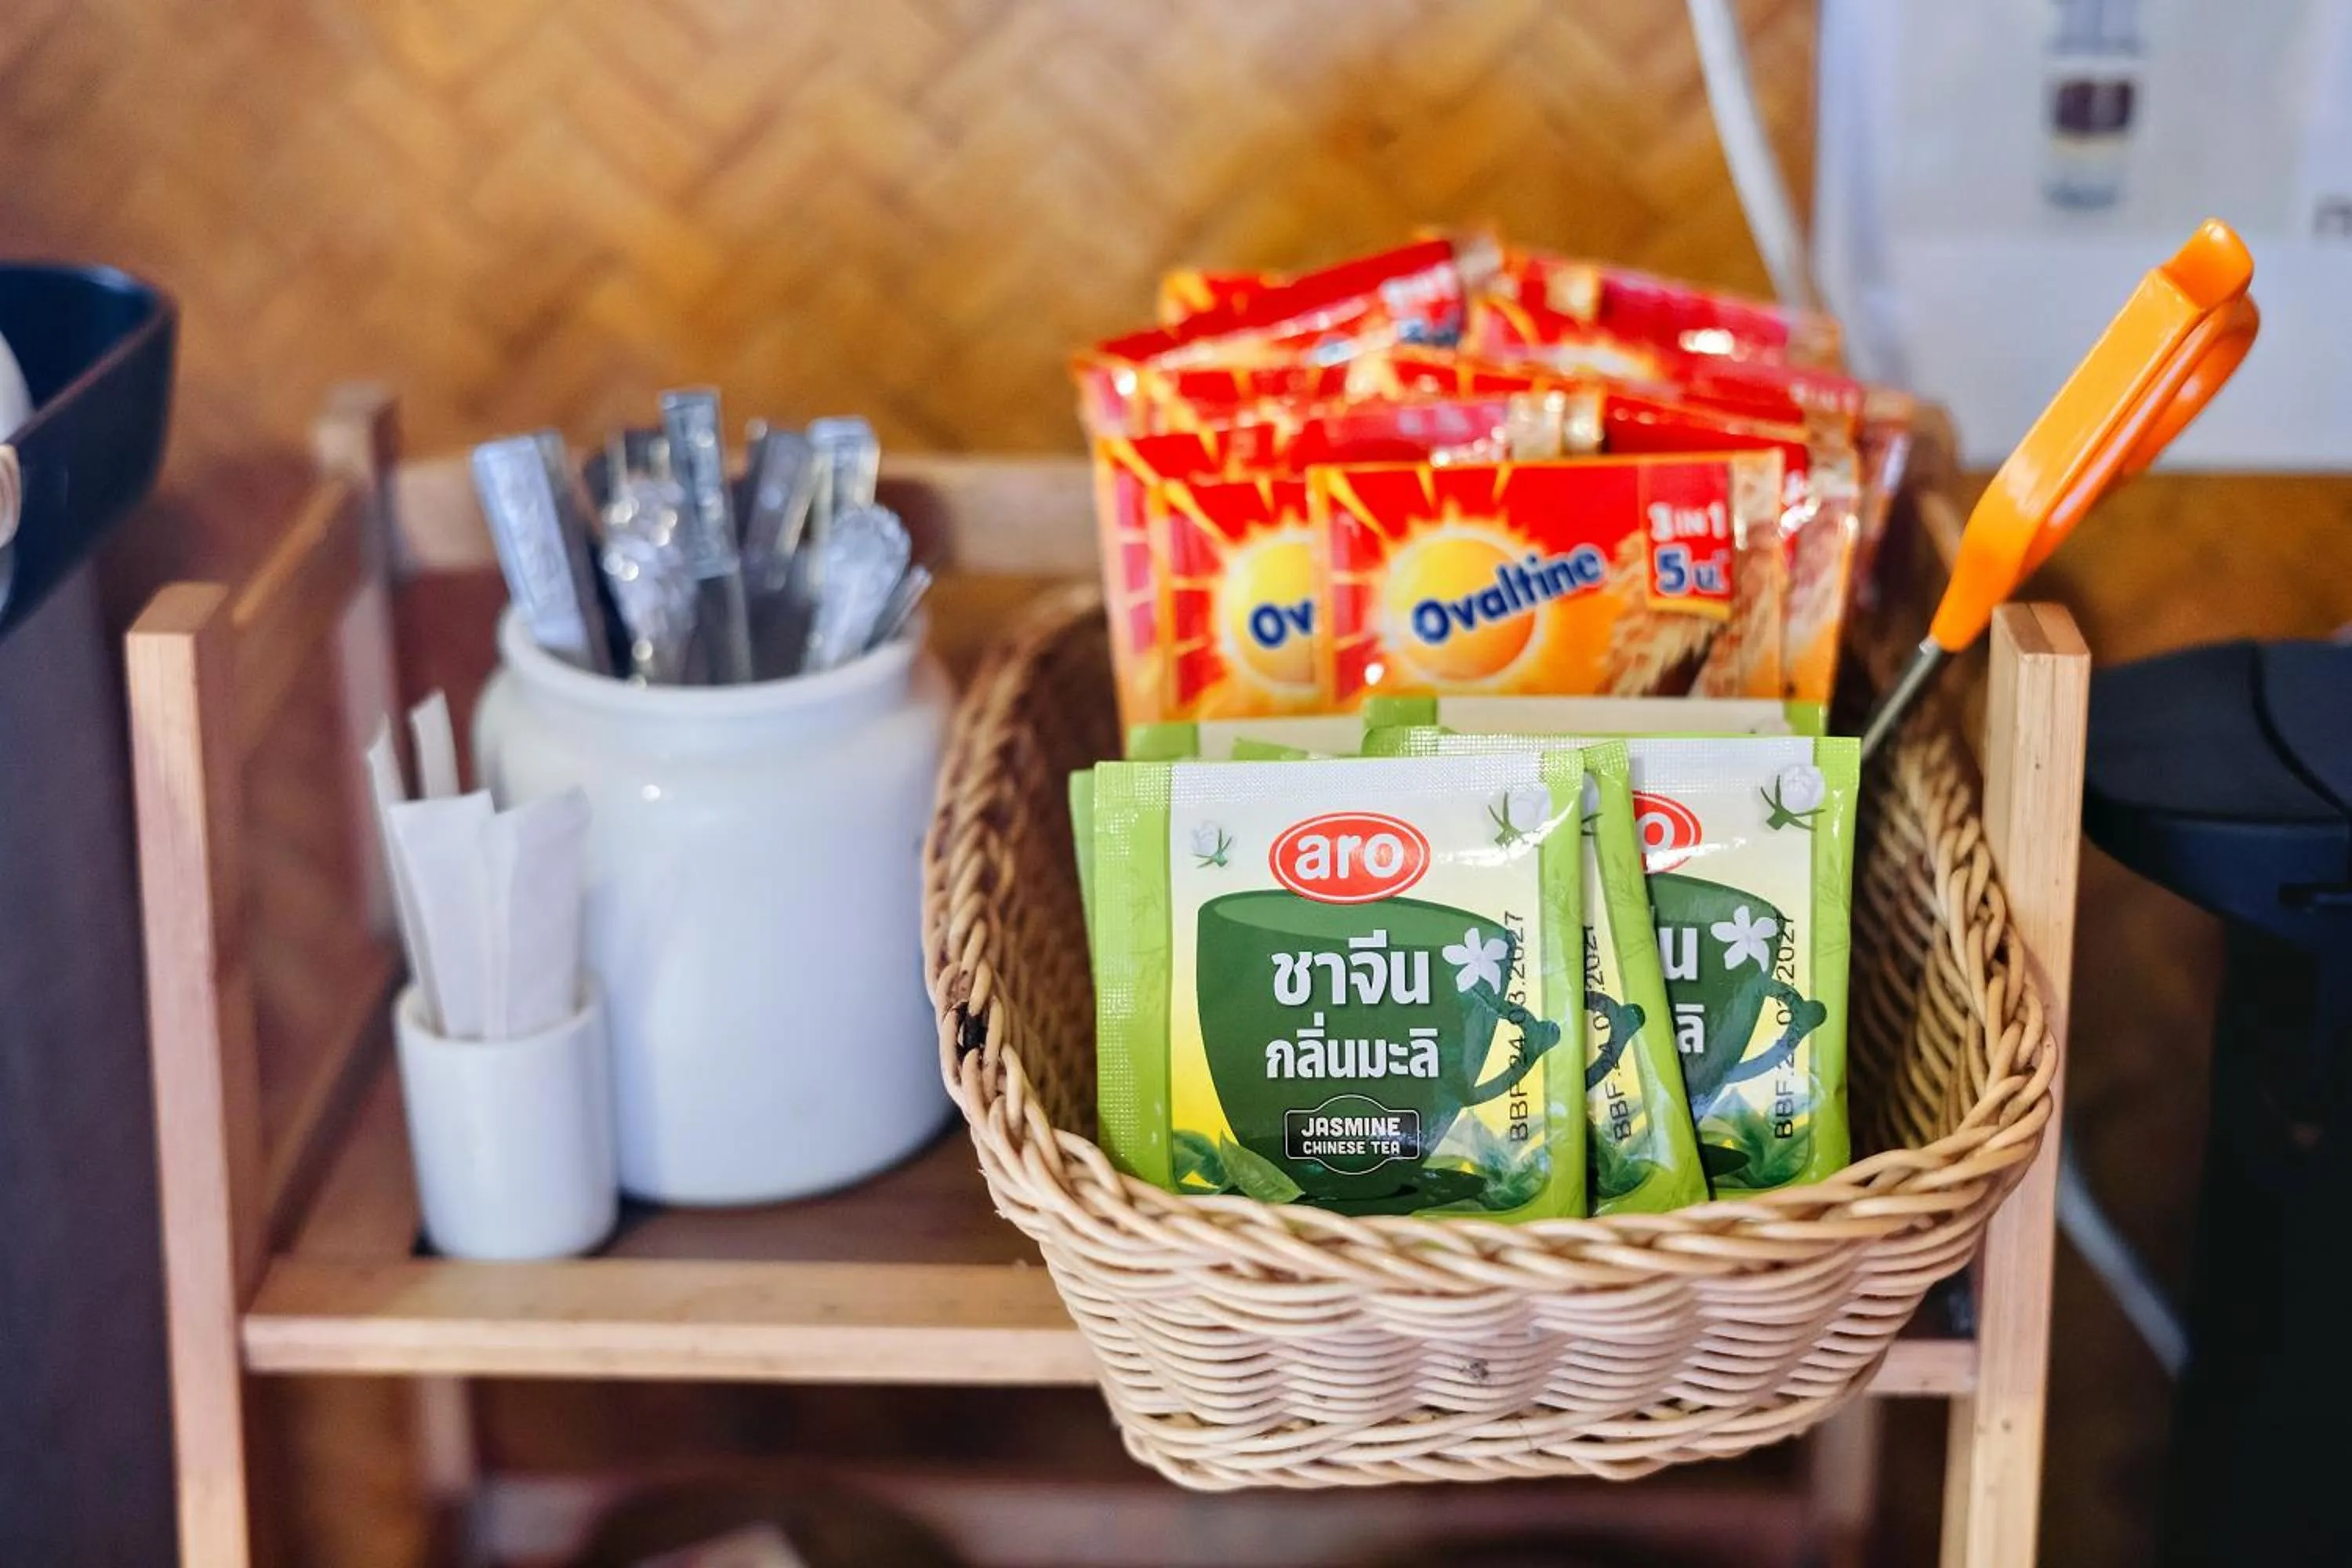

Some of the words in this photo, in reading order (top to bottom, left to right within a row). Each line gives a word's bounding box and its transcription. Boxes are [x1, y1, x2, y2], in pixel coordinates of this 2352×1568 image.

[1411, 547, 1603, 645] Ovaltine
[1657, 546, 1689, 595] 5
[1295, 833, 1404, 880] aro
[1271, 929, 1430, 1006] ชาจีน
[1265, 1011, 1439, 1079] กลิ่นมะลิ
[1504, 910, 1529, 1142] BBF2403.2027
[1301, 1116, 1401, 1137] JASMINE
[1302, 1141, 1366, 1155] CHINESE
[1370, 1141, 1400, 1155] TEA
